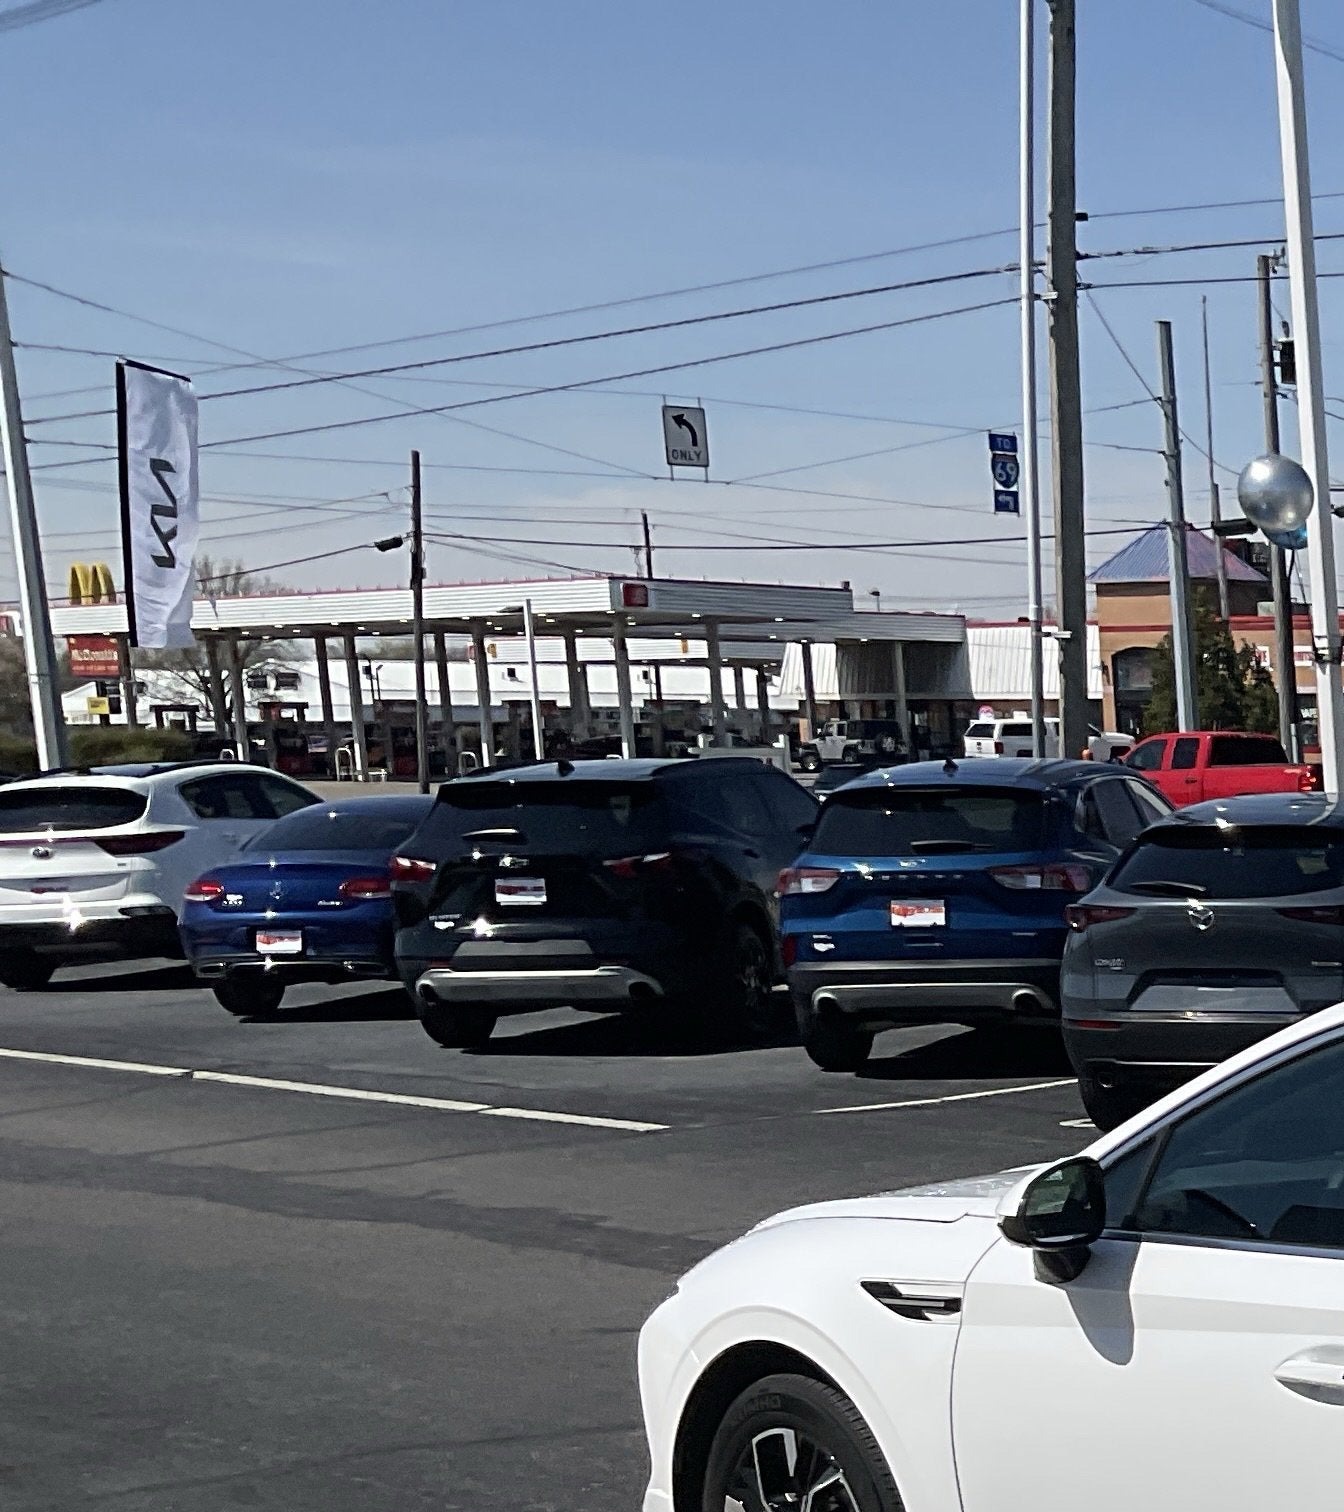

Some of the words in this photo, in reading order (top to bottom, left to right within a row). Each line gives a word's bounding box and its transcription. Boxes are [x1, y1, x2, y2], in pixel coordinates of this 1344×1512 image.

[996, 437, 1011, 449] TO
[671, 448, 702, 461] ONLY
[995, 462, 1017, 481] 69
[150, 457, 178, 569] KIA
